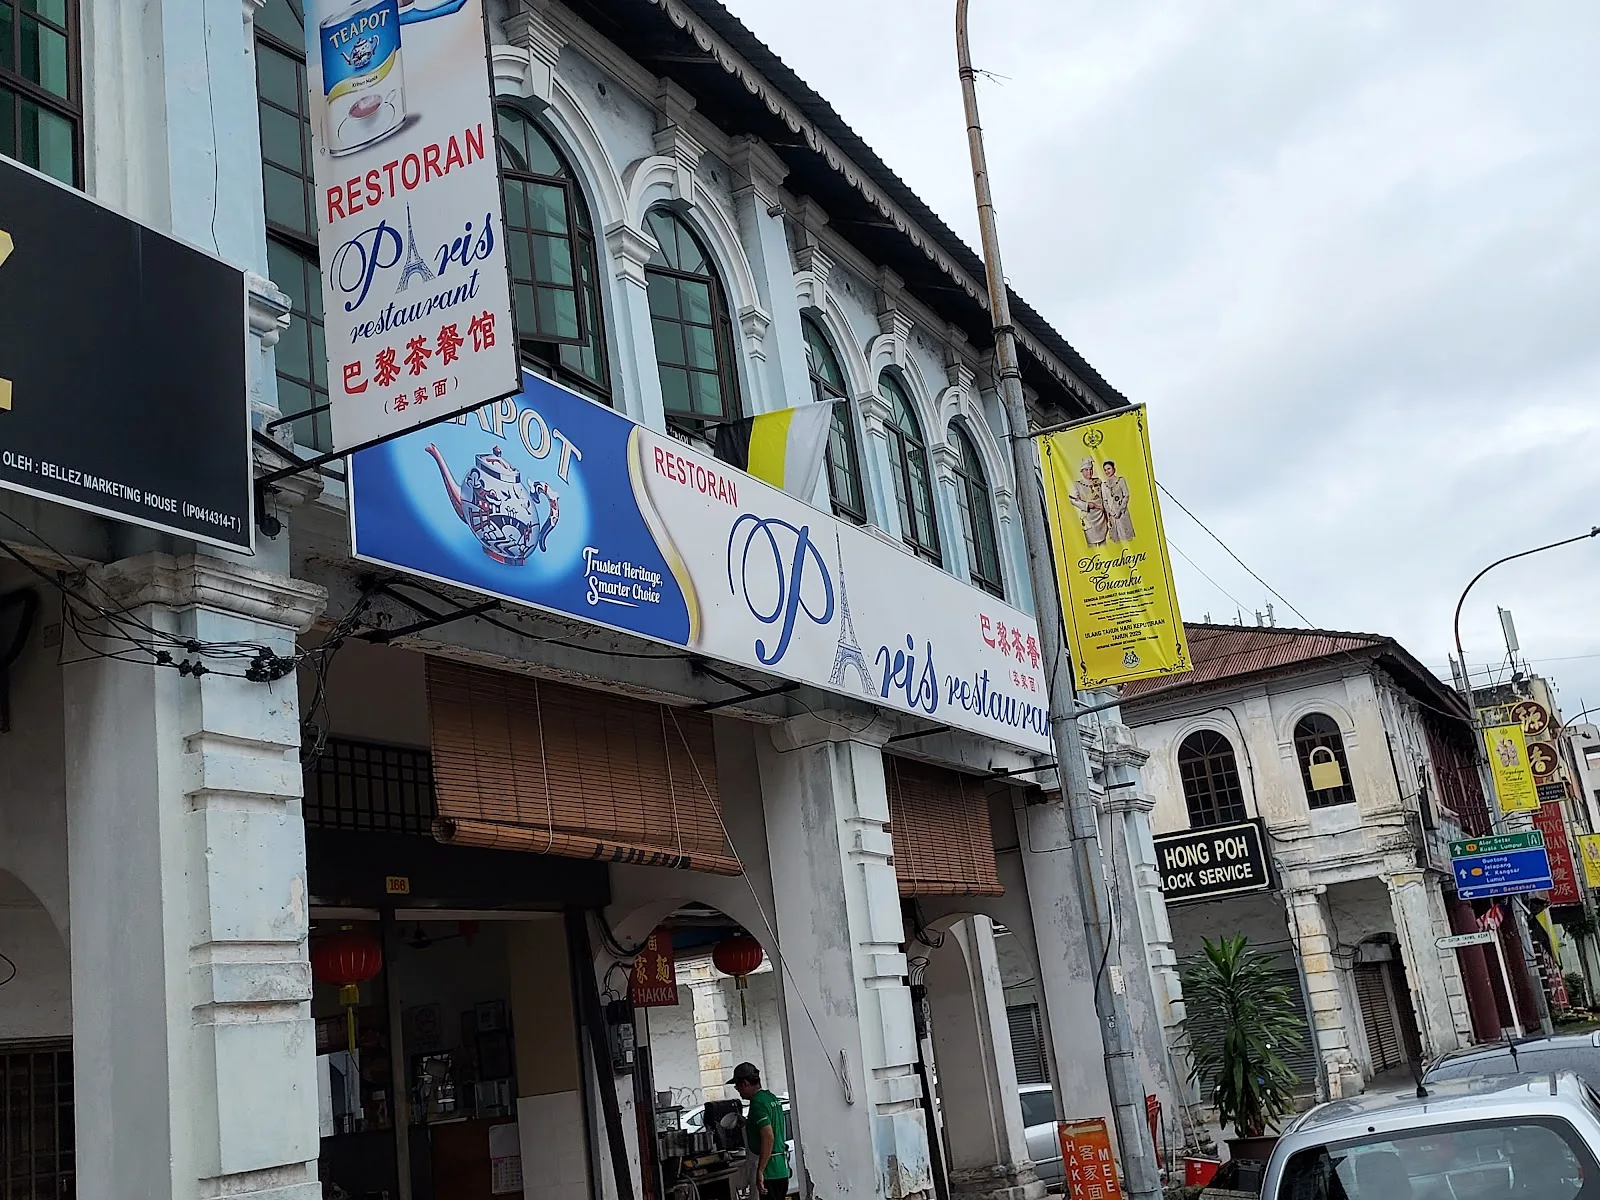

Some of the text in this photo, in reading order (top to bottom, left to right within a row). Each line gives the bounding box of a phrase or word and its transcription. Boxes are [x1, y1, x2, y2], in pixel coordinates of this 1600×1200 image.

[329, 9, 390, 49] TEAPOT
[326, 123, 485, 224] RESTORAN
[350, 269, 480, 344] restaurant
[342, 310, 496, 394] 巴黎茶餐馆
[2, 451, 33, 473] OLEH
[41, 462, 82, 486] BELLEZ
[84, 473, 142, 503] MARKETING
[144, 492, 178, 513] HOUSE
[654, 446, 738, 508] RESTORAN
[582, 546, 663, 588] Trusted Heritage,
[1078, 548, 1147, 574] Dirgahayu
[1089, 568, 1142, 593] Tuanku
[586, 575, 661, 606] Smarter Choice
[980, 613, 1040, 669] 巴黎茶餐
[1164, 835, 1249, 870] HONG POH
[1500, 842, 1523, 850] Lumpur
[1546, 836, 1567, 850] UAN
[389, 879, 406, 891] 166
[1160, 862, 1254, 892] LOCK SERVICE
[637, 986, 675, 1004] HAKKA
[1065, 1140, 1085, 1200] HAKK
[1098, 1148, 1115, 1192] MEE
